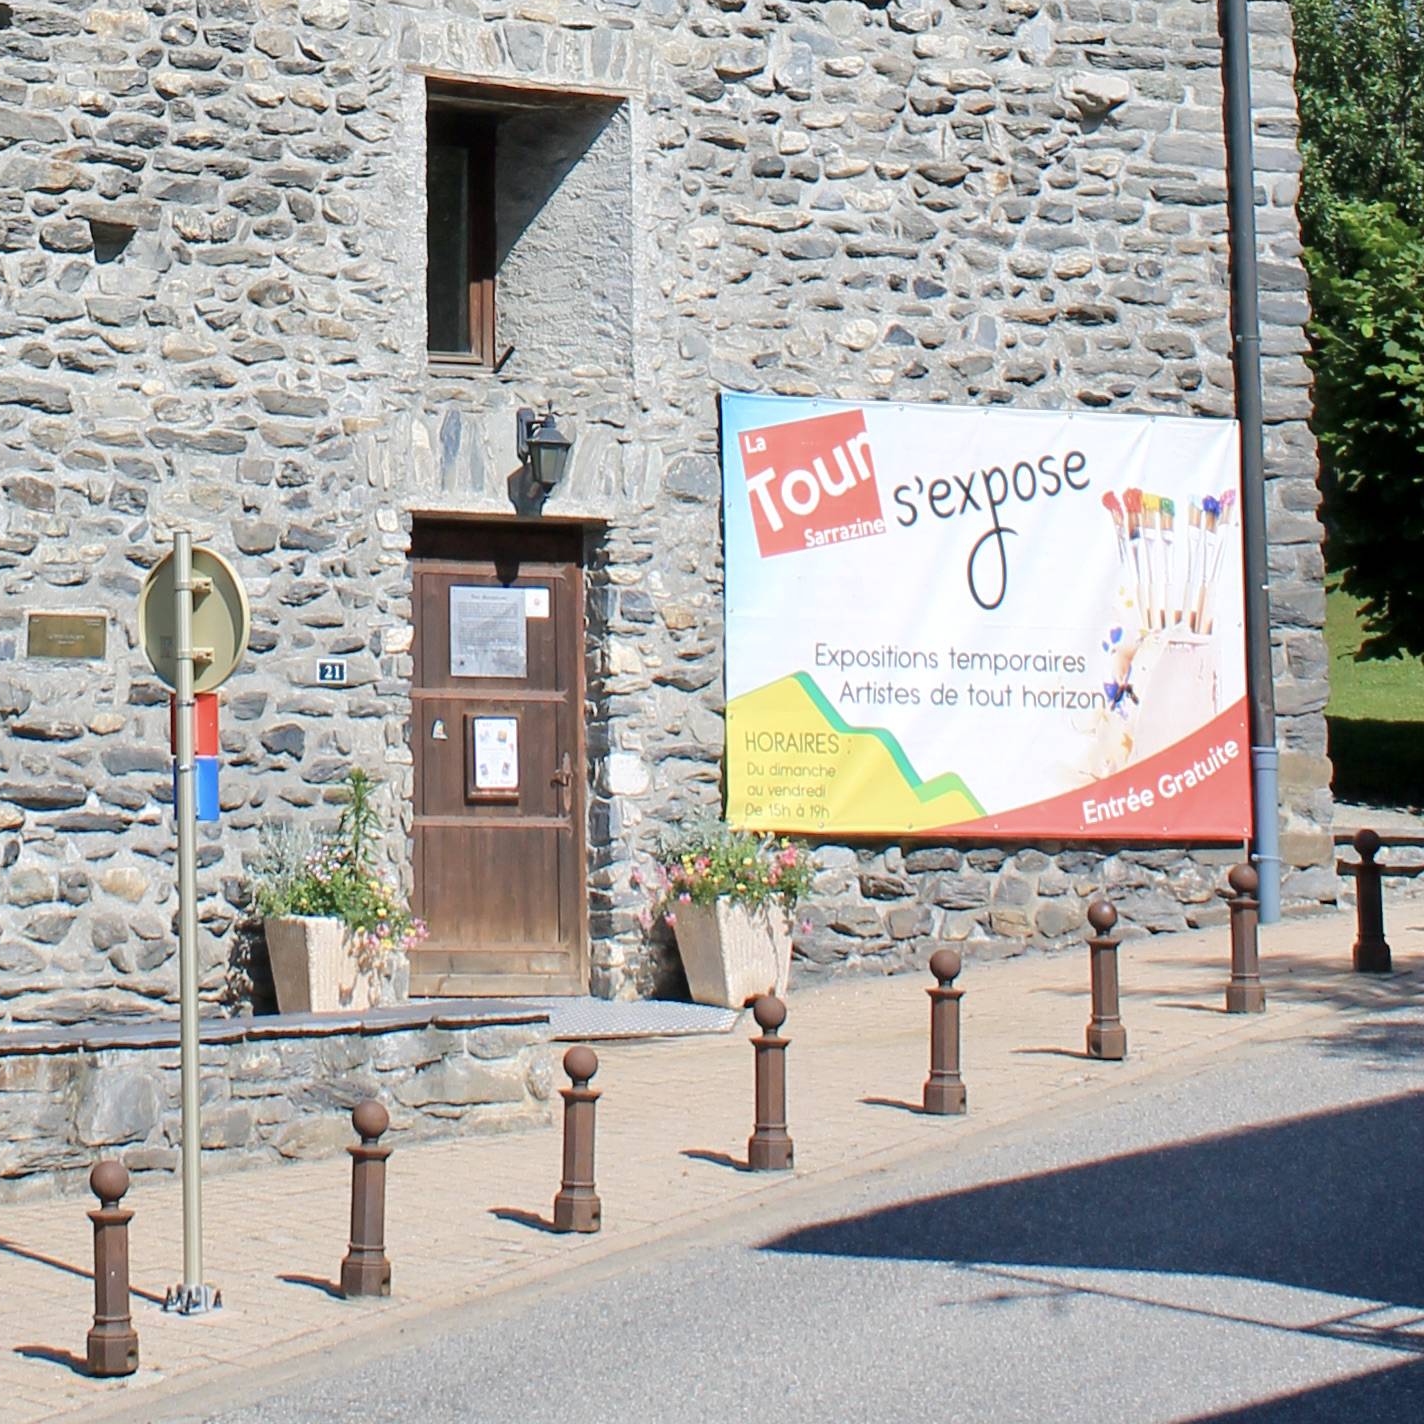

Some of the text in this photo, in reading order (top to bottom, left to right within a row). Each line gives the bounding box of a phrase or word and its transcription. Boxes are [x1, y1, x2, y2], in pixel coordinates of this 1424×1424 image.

[744, 435, 767, 454] La
[746, 432, 872, 532] Tour
[804, 518, 885, 547] Sarrazine
[815, 643, 1086, 675] Expositions temporaires
[324, 665, 340, 679] 21
[839, 680, 1106, 709] Artistes de tout horizon
[745, 731, 839, 754] HORAIRES
[747, 761, 836, 778] Du dimanche
[747, 783, 826, 798] au vendredi
[1082, 740, 1239, 824] Entrée Gratuite
[745, 802, 831, 819] De 15h à 19h
